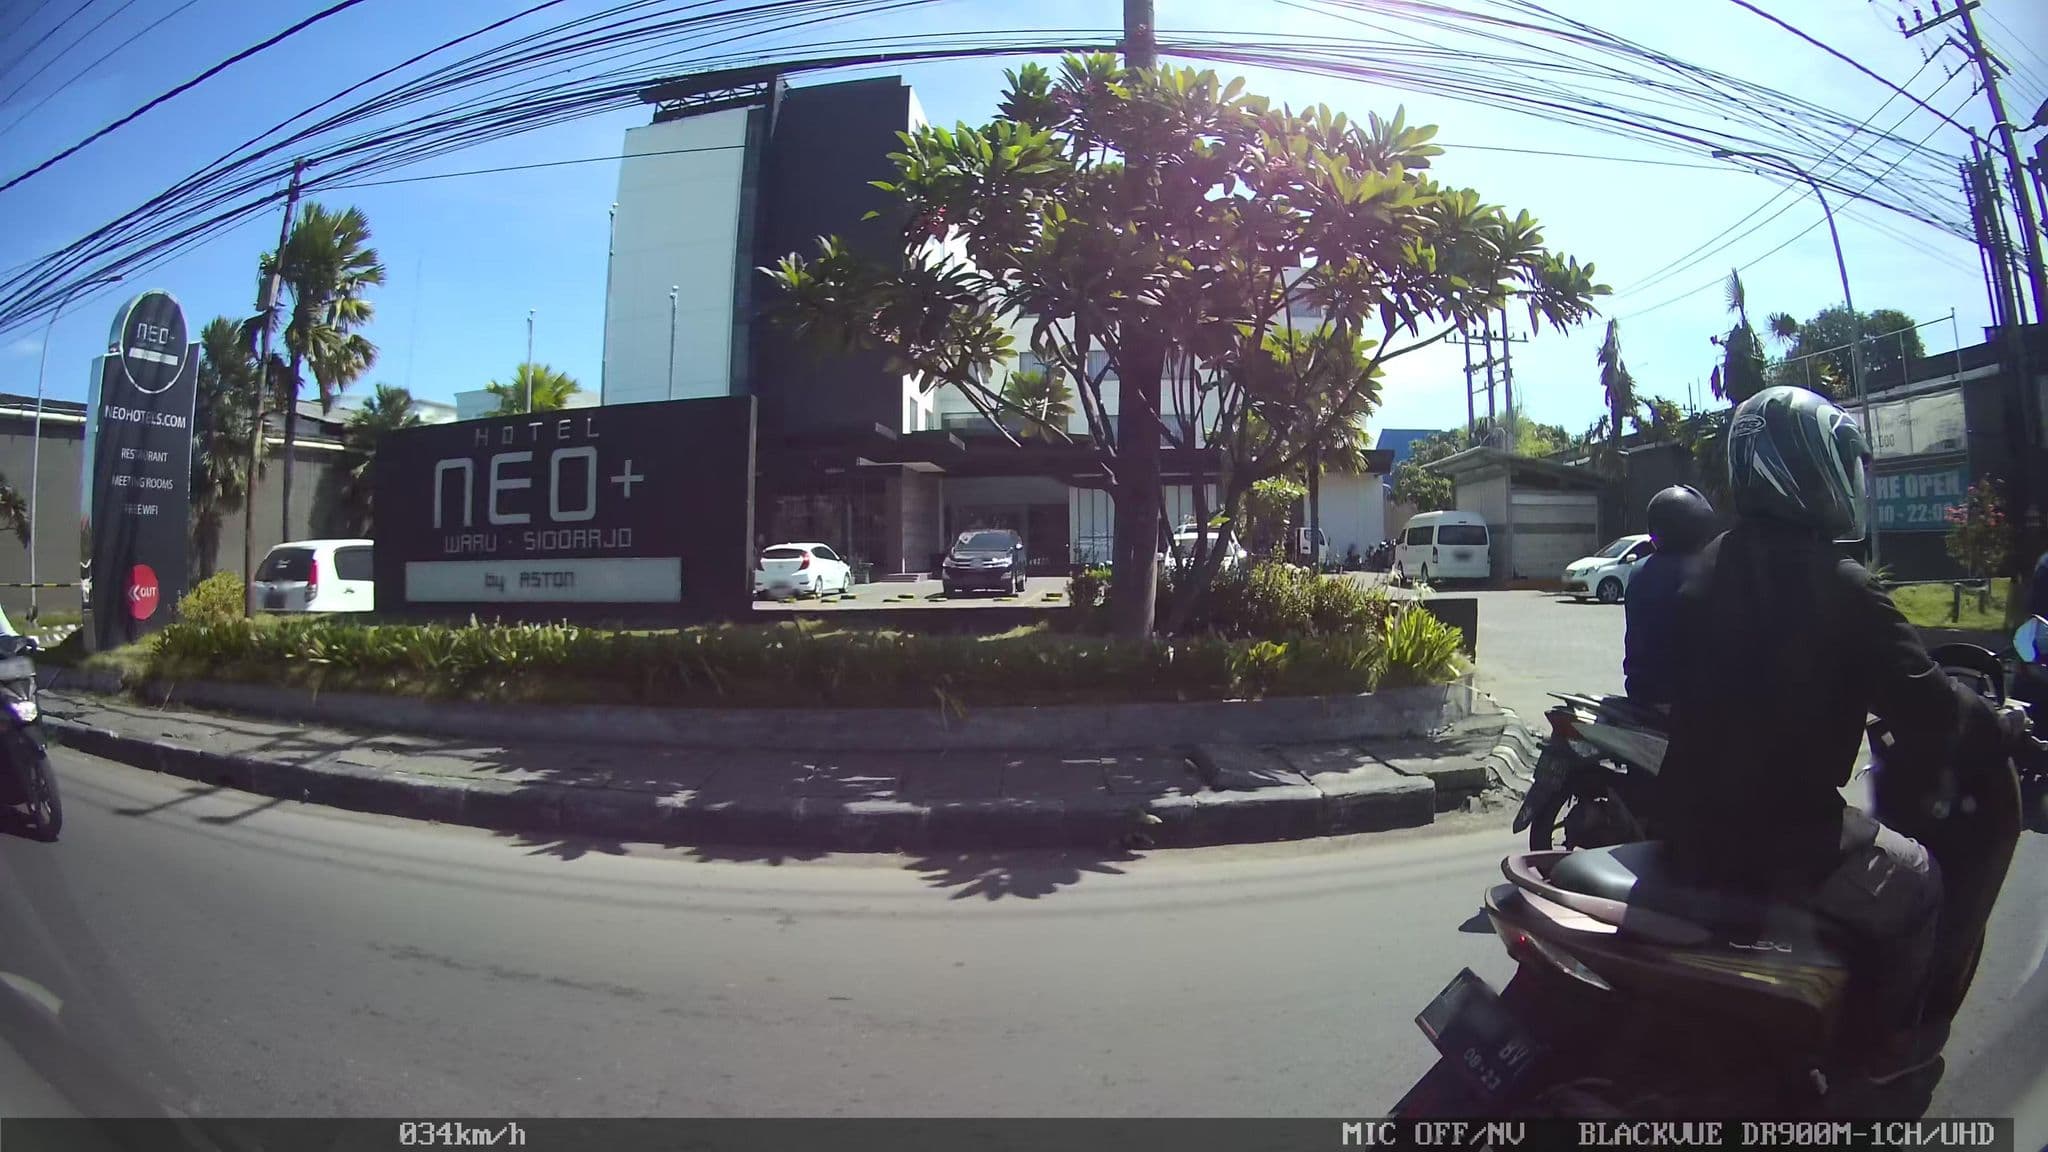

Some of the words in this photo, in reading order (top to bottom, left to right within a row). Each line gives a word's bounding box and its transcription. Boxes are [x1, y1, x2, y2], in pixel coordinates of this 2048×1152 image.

[105, 405, 186, 429] NEOHOTELS.COM
[474, 417, 600, 447] HOTEL
[121, 448, 169, 462] RESTAURANT
[146, 478, 174, 490] ROOMS
[1904, 471, 1960, 498] OPEN
[142, 504, 159, 516] WIFI
[445, 534, 497, 553] WARU
[523, 528, 632, 551] SIDOARJO
[140, 586, 157, 598] OUT
[484, 573, 505, 592] by
[519, 571, 576, 589] ASTON
